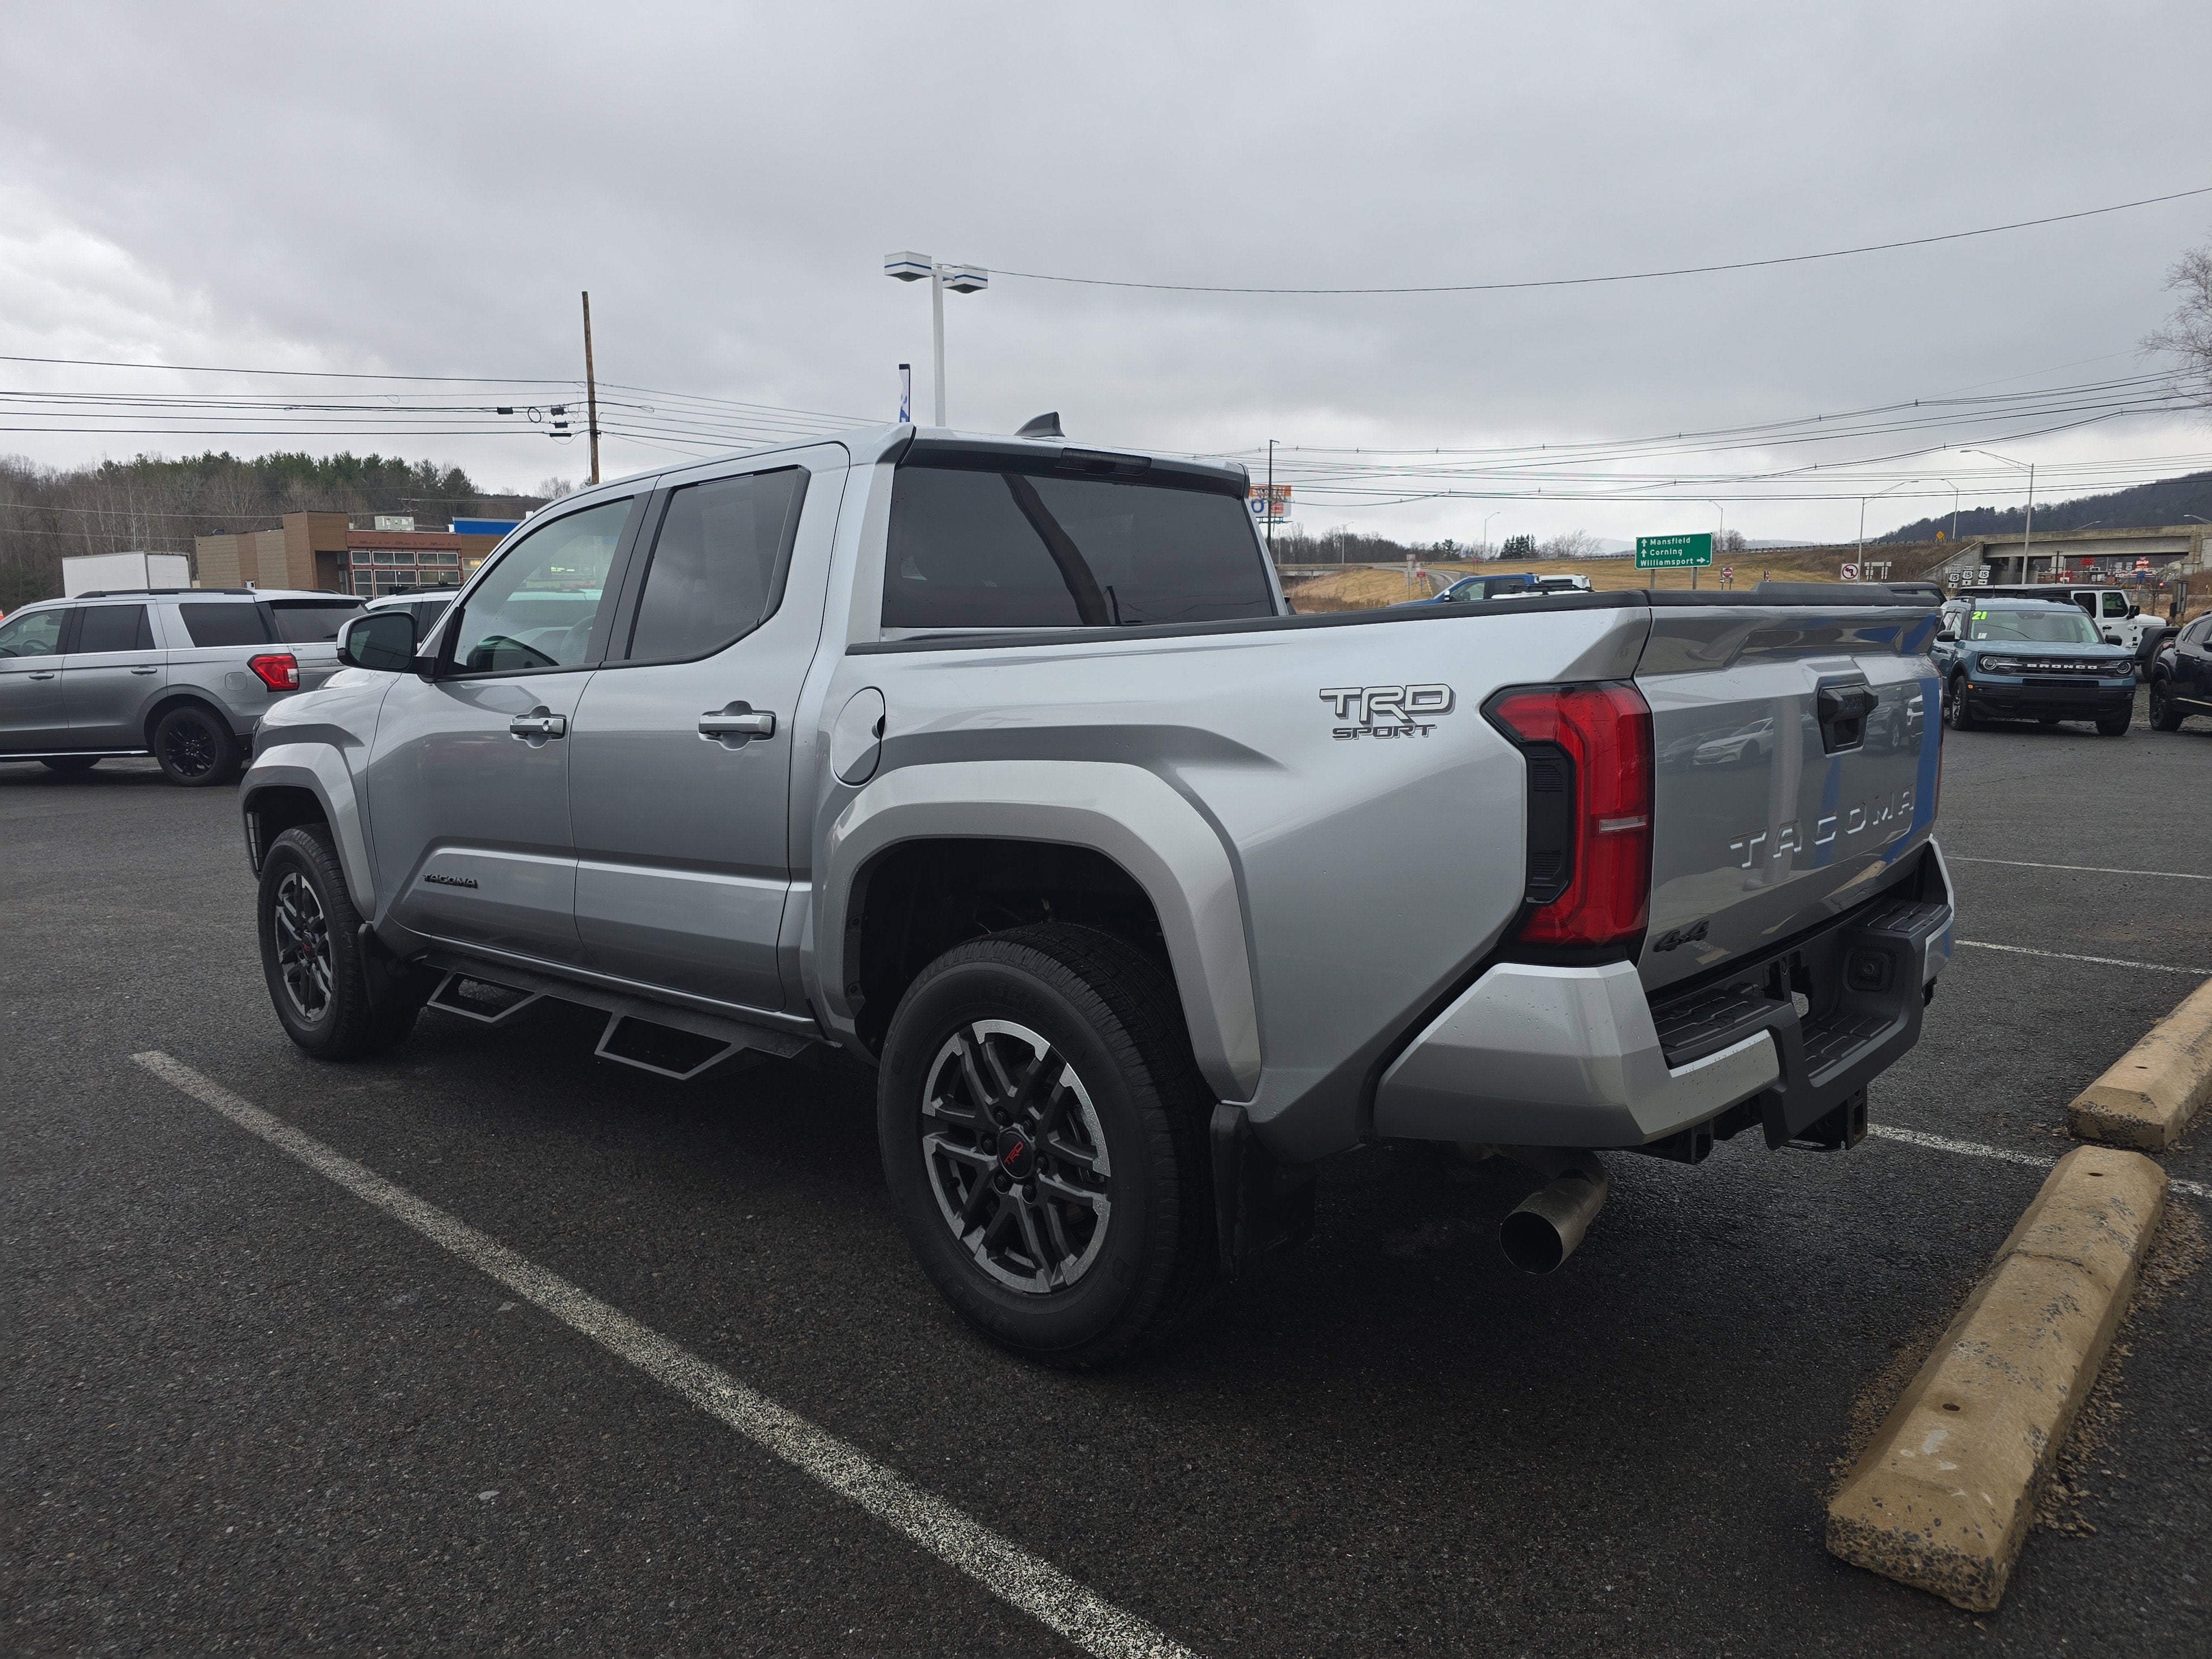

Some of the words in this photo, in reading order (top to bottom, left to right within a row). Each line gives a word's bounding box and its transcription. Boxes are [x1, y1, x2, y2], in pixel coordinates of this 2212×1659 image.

[1650, 537, 1690, 545] Mansfield
[1641, 558, 1693, 567] Williamsport
[1972, 611, 1988, 620] 21
[1319, 683, 1456, 726] TRD
[1333, 724, 1437, 740] SPORT
[1728, 783, 1915, 869] TACOMA
[422, 874, 478, 889] TACOMA
[1004, 1141, 1024, 1165] TRD
